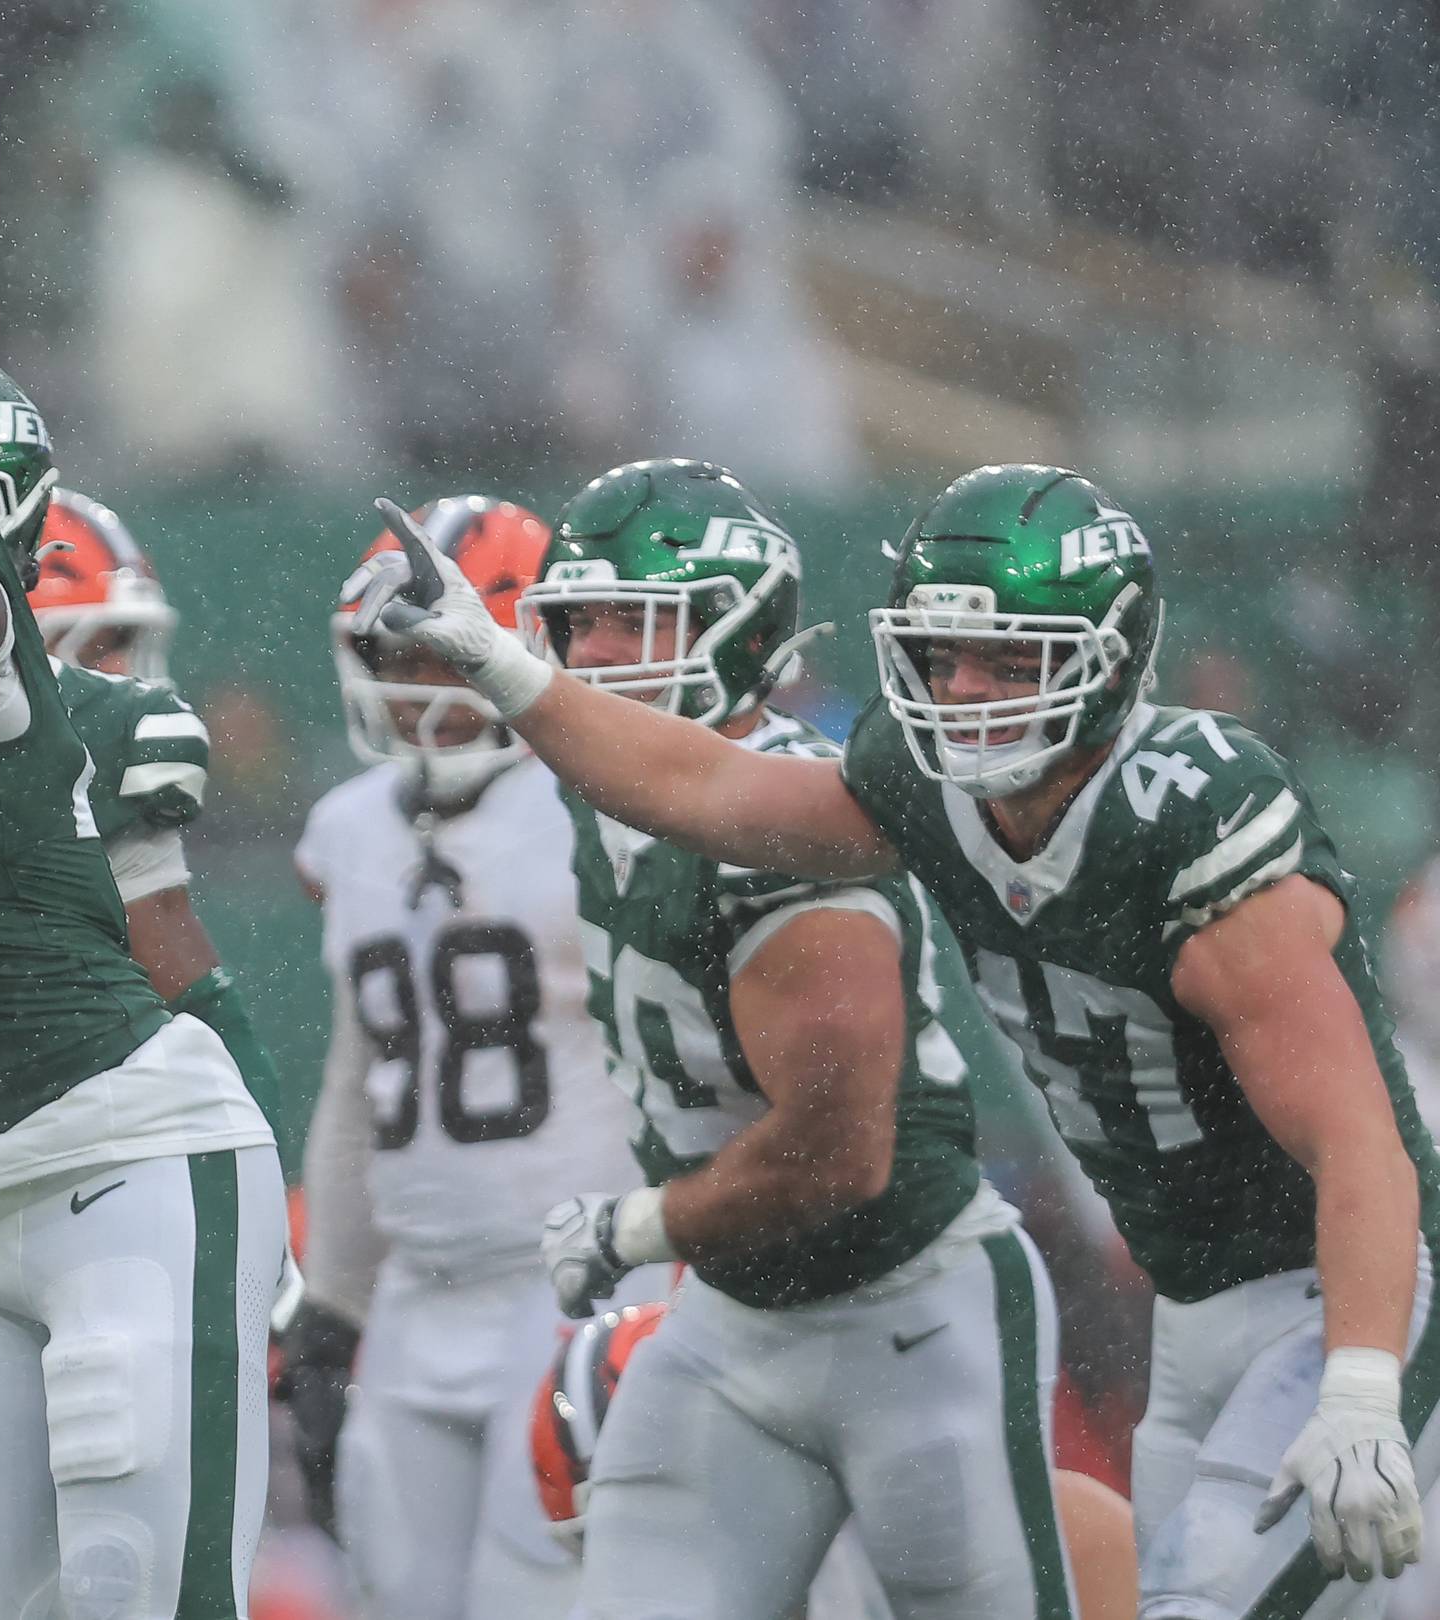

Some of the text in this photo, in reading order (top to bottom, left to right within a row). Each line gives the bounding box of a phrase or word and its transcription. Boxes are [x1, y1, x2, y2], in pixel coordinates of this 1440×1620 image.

[1121, 711, 1240, 822] 47
[351, 920, 550, 1150] 98
[974, 947, 1204, 1150] 47
